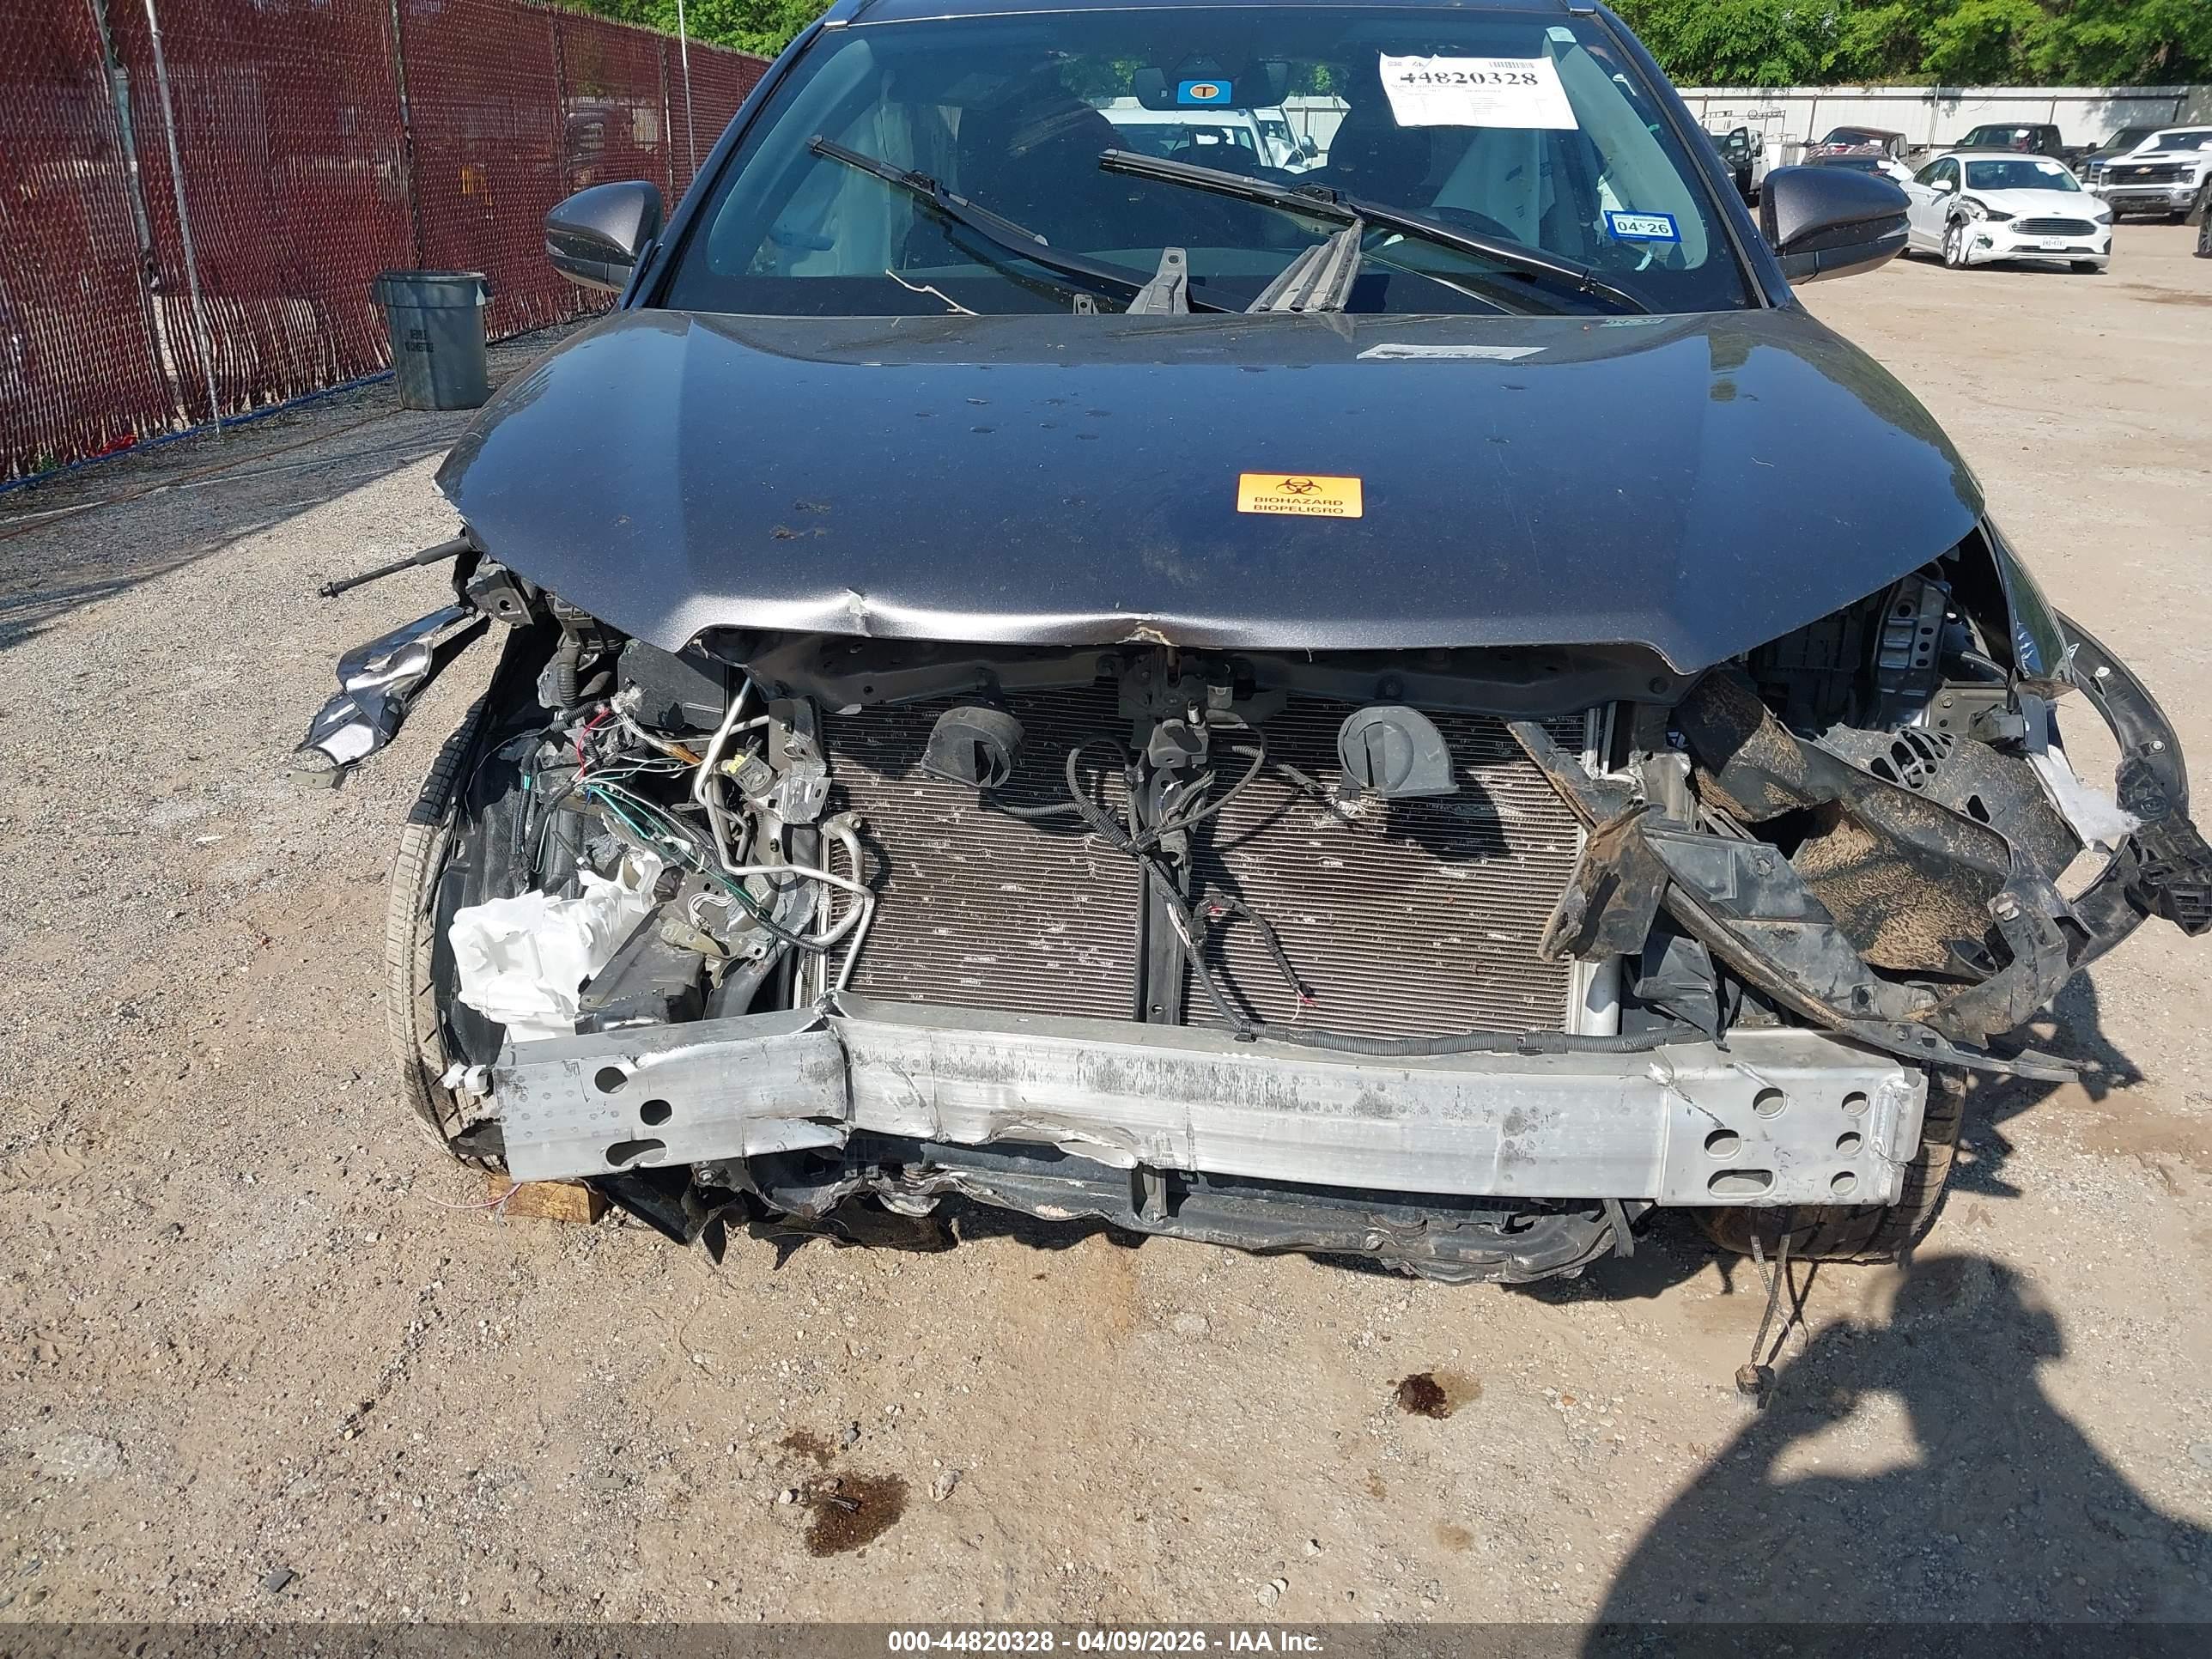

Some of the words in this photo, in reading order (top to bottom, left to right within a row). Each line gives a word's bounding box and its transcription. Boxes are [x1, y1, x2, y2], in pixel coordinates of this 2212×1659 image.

[1400, 71, 1539, 86] 44820328
[1617, 221, 1639, 232] 04
[1647, 222, 1669, 234] 26
[1254, 496, 1344, 506] BIOHAZARD
[1253, 504, 1344, 514] BIOPELIGRO
